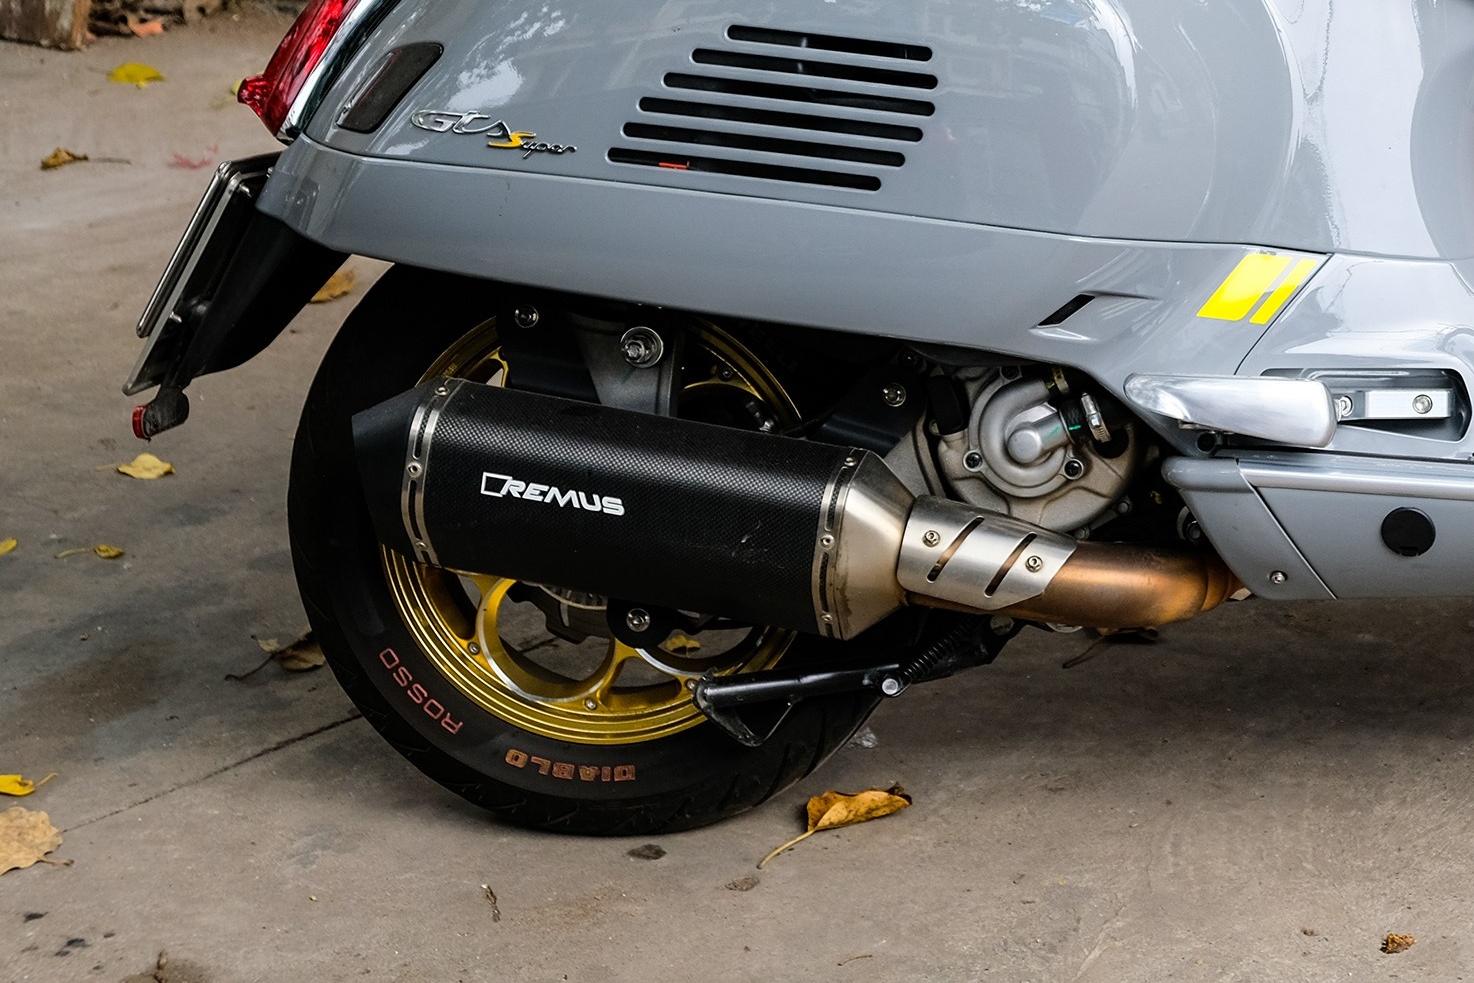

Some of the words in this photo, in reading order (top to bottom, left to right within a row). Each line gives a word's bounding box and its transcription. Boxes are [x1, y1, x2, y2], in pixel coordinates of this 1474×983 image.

[500, 477, 626, 516] REMUS
[378, 648, 464, 735] ROSSO
[504, 748, 636, 782] DIABLO
